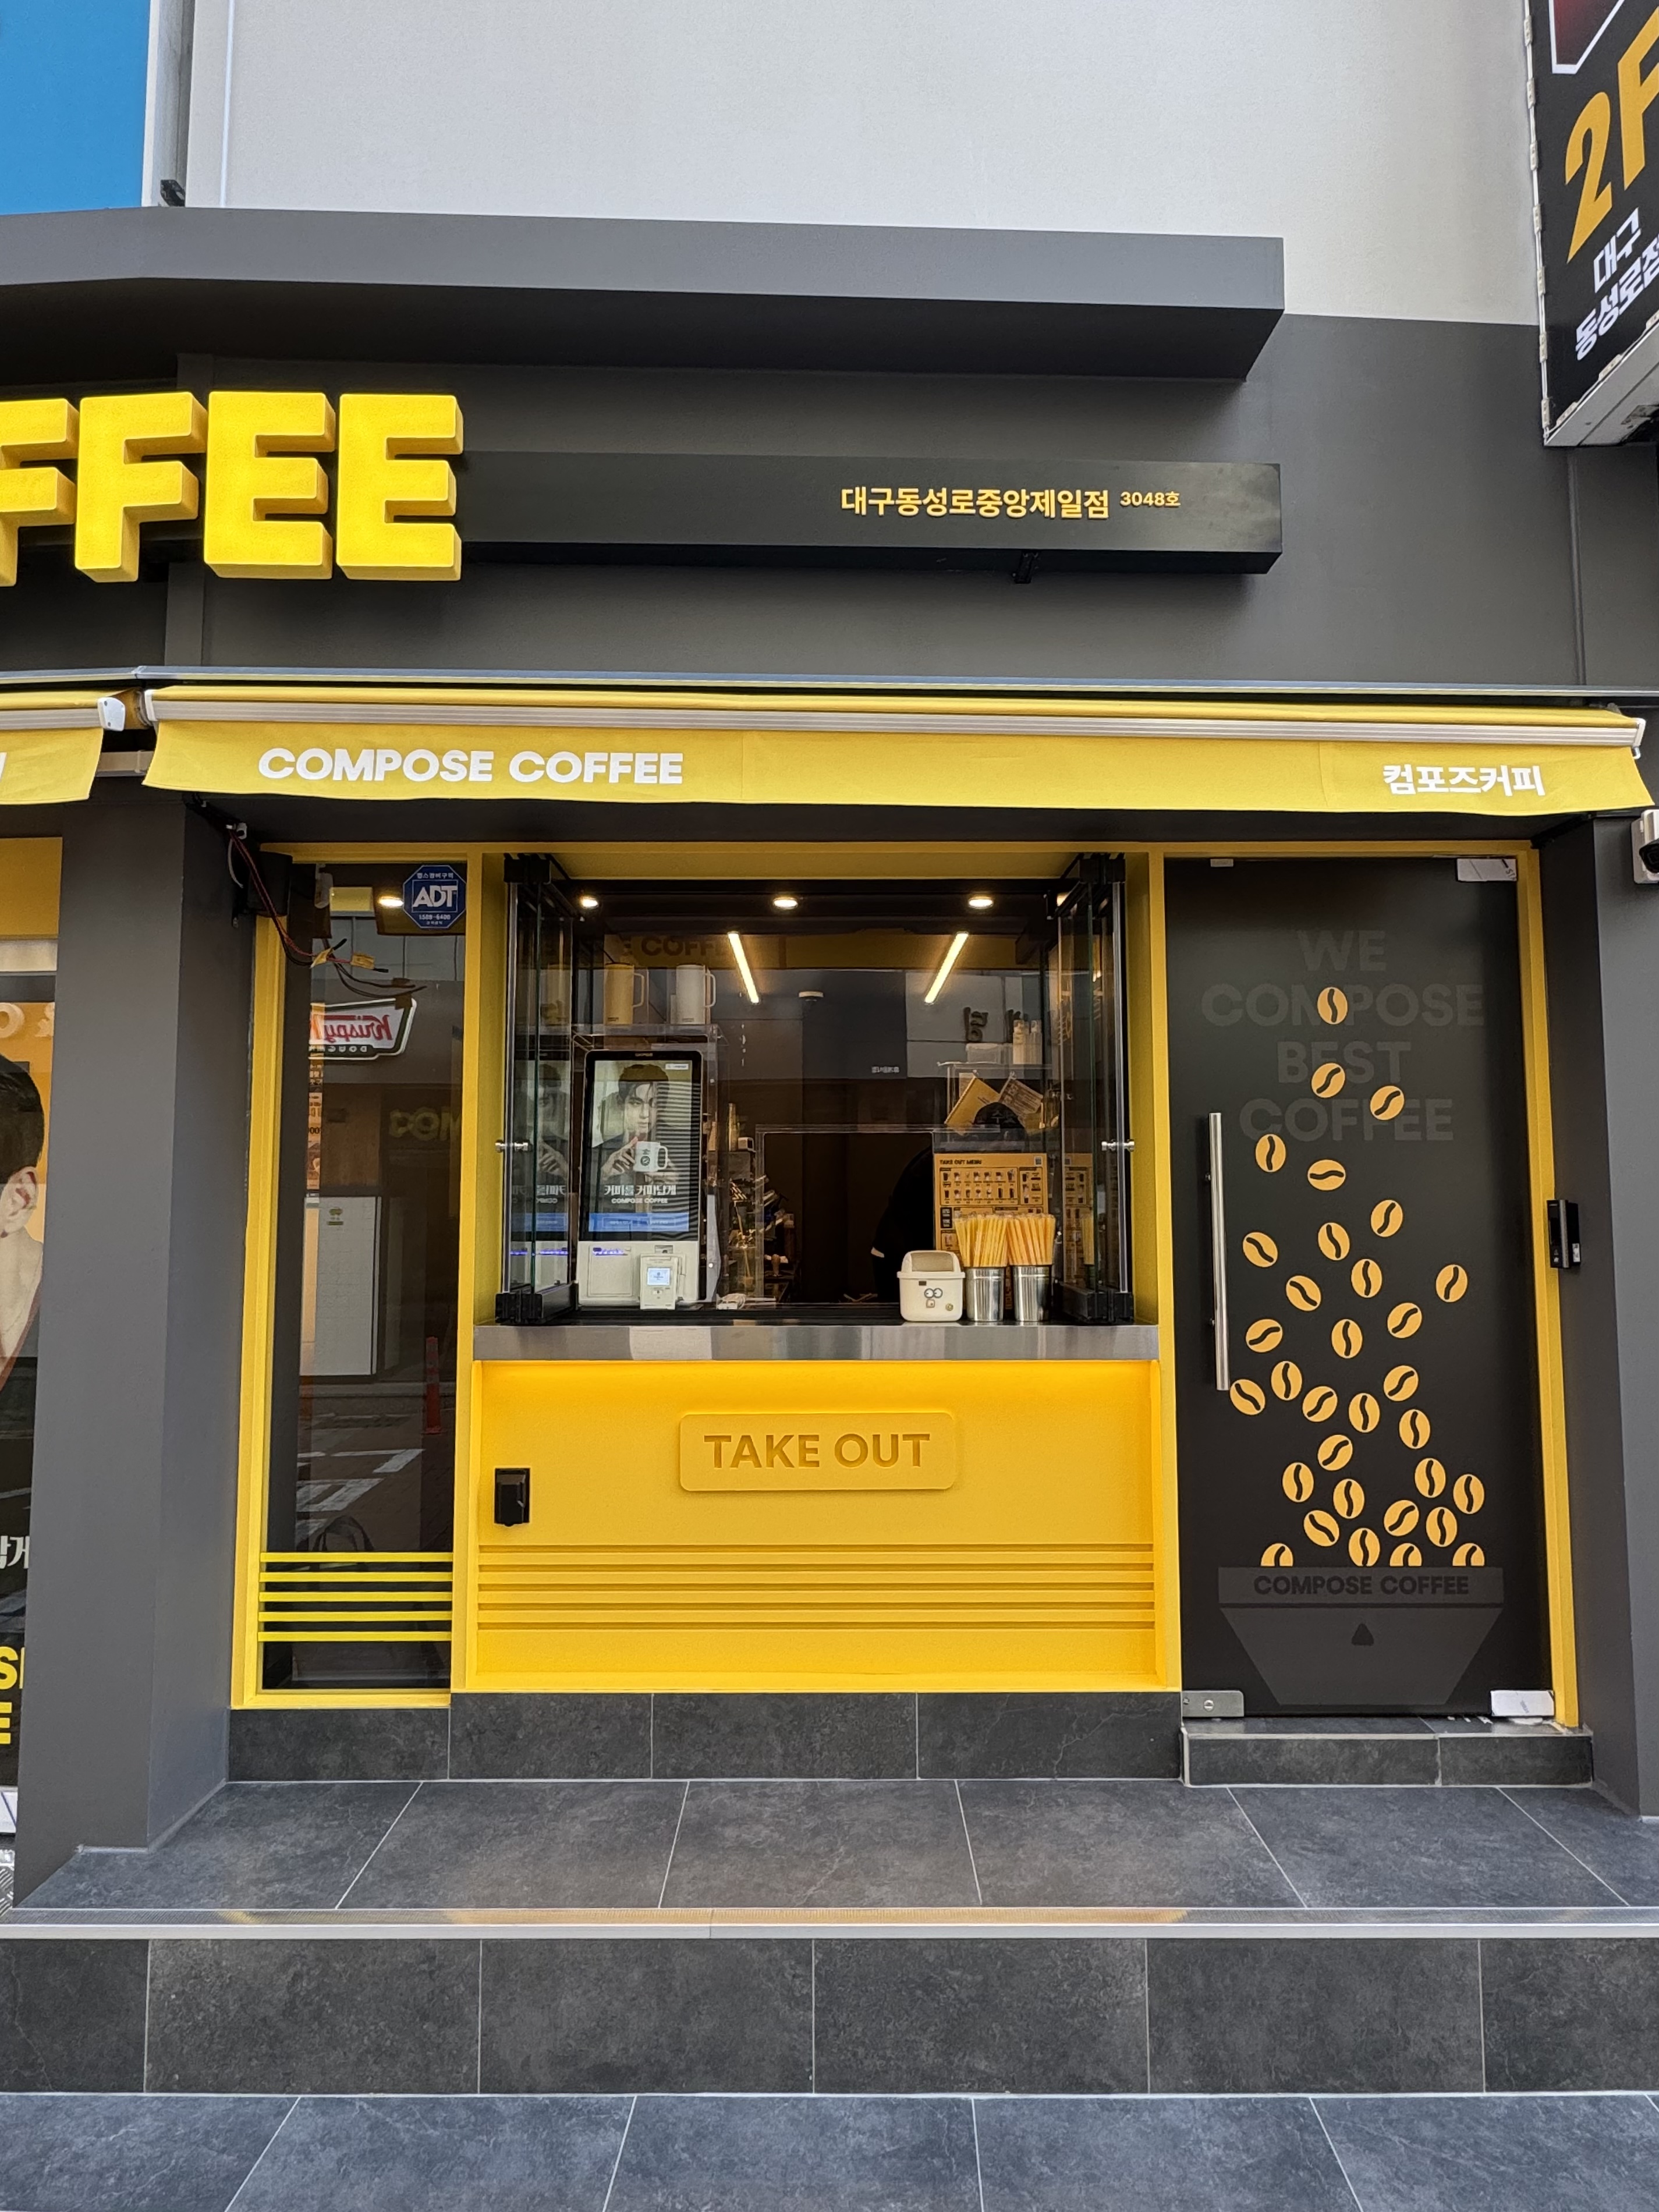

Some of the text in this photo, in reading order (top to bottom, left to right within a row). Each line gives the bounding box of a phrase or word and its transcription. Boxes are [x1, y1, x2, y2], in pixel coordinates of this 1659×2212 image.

[1593, 207, 1642, 294] 대구
[841, 487, 1181, 520] 대구동성로중앙제일점 3048호
[258, 748, 683, 784] COMPOSE COFFEE
[1383, 764, 1545, 796] 컴포즈커피
[413, 885, 457, 907] ADT
[1296, 930, 1387, 972] WE
[704, 1434, 930, 1469] TAKE OUT
[1254, 1576, 1469, 1594] COMPOSE COFFEE
